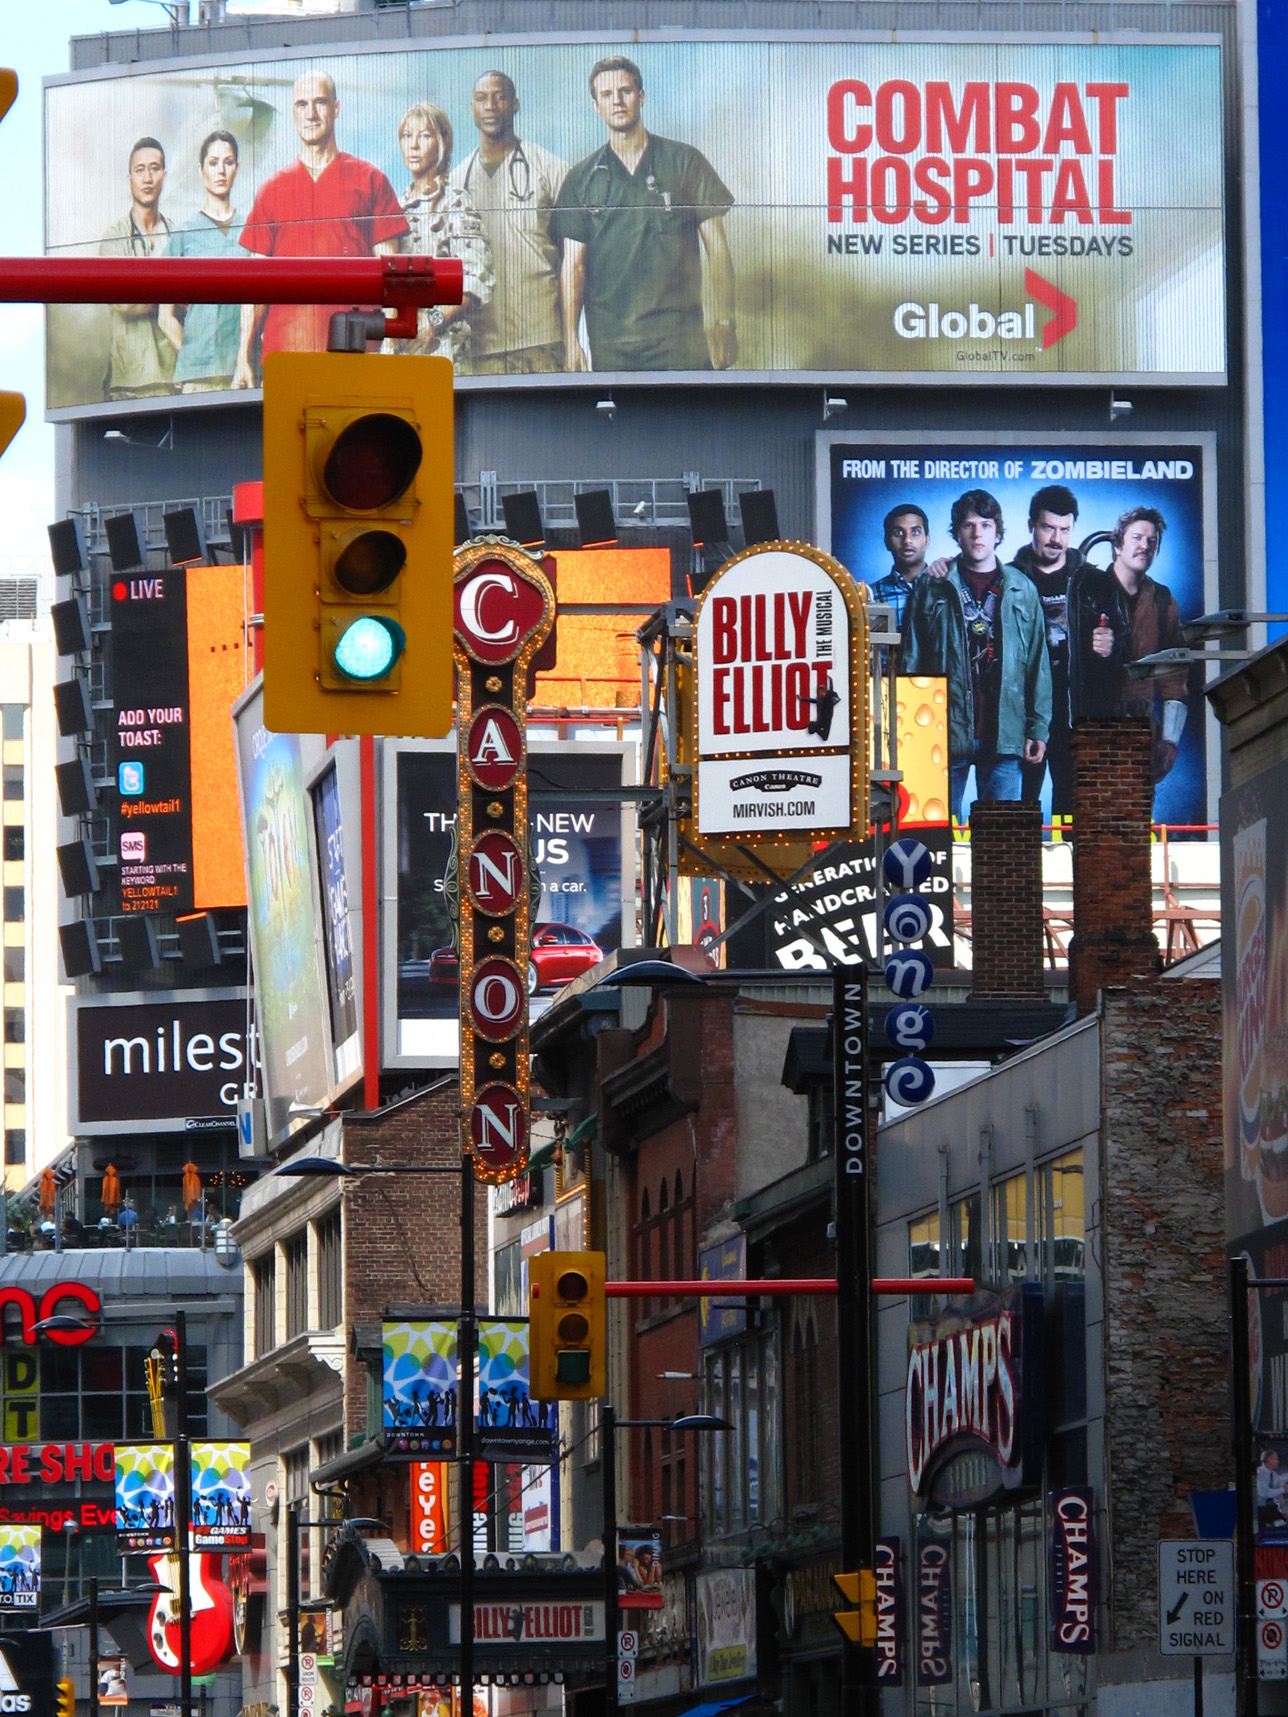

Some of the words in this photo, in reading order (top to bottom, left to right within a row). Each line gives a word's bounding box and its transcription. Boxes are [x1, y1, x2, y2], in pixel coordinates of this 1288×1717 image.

[827, 78, 1130, 155] COMBAT
[827, 155, 1133, 225] HOSPITAL
[827, 234, 883, 255] NEW
[892, 234, 981, 255] SERIES
[1003, 235, 1134, 256] TUESDAYS
[893, 302, 1035, 339] Global
[956, 350, 1035, 362] GlobalTV.com
[842, 459, 886, 479] FROM
[891, 460, 920, 479] THE
[924, 460, 999, 479] DIRECTOR
[1004, 460, 1024, 479] OF
[1030, 460, 1194, 480] ZOMBIELAND
[130, 579, 164, 599] LIVE
[815, 589, 833, 637] MUSICAL
[712, 590, 813, 665] BILLY
[815, 639, 832, 658] THE
[118, 710, 144, 726] ADD
[147, 707, 183, 724] YOUR
[118, 729, 162, 747] TOAST:
[732, 774, 767, 788] CANON
[771, 773, 819, 785] THEATRE
[120, 799, 181, 816] #yellowtail1
[733, 800, 816, 818] MIRVISH.COM
[122, 840, 144, 852] SMS
[121, 864, 154, 876] STARTING
[155, 863, 172, 874] WITH
[173, 862, 188, 873] THE
[460, 573, 520, 1151] CANON
[120, 875, 156, 886] KEYWORD
[844, 983, 863, 1174] DOWNTOWN
[239, 1112, 252, 1145] N
[905, 1309, 1017, 1497] CHAMPS
[195, 1534, 249, 1545] GameStop
[210, 1526, 247, 1535] GAMES
[1177, 1549, 1216, 1563] STOP
[1056, 1495, 1090, 1644] CHAMPS
[1177, 1570, 1216, 1584] HERE
[16, 1594, 34, 1605] TIX
[1203, 1591, 1224, 1605] ON
[876, 1543, 897, 1678] CHAMPS
[1194, 1611, 1224, 1626] RED
[473, 1607, 511, 1639] ILLY
[525, 1605, 583, 1638] ELLIOT
[1169, 1633, 1226, 1647] SIGNAL
